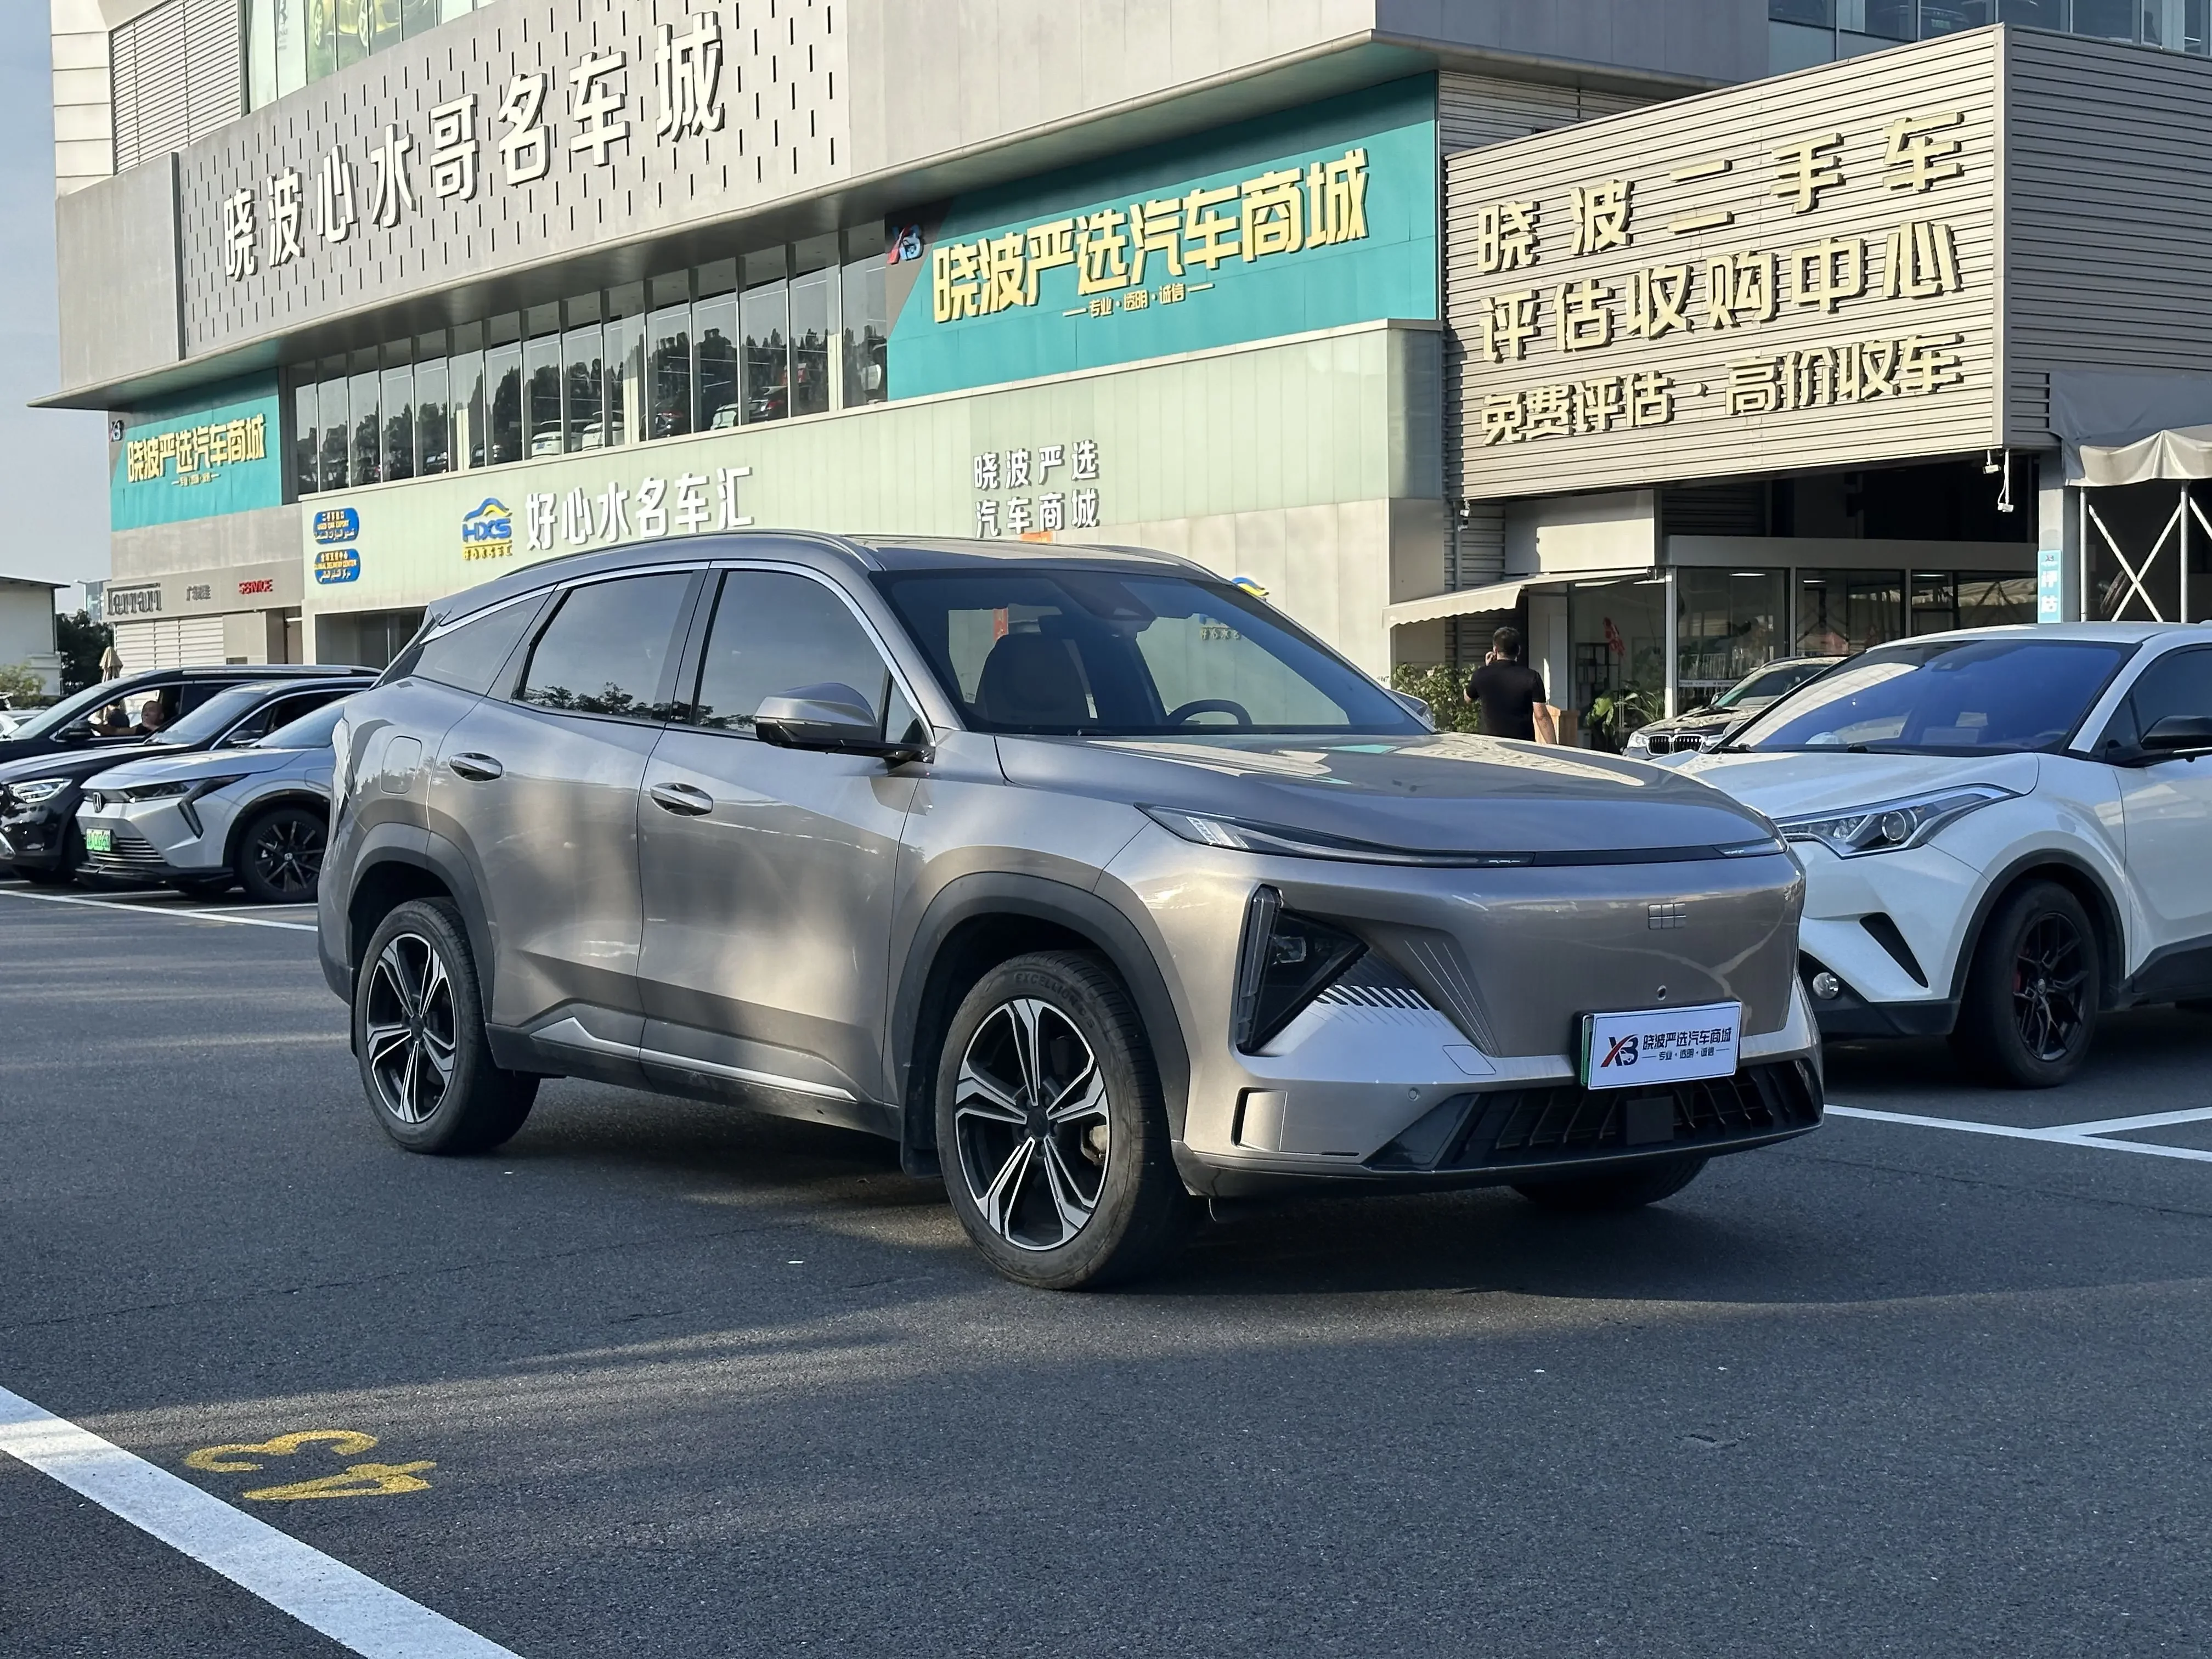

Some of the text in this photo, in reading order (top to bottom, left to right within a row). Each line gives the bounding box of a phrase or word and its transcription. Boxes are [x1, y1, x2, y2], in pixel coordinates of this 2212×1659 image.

[222, 11, 725, 282] 晓波心水哥名车城
[1477, 111, 1964, 273] 晓波二手车
[932, 147, 1370, 325] 晓波严选汽车商城
[1479, 222, 1964, 363] 评估收购中心
[1480, 332, 1964, 447] 免费评估·高价收车
[127, 413, 267, 483] 晓波严选汽车商城
[973, 439, 1101, 492] 晓波严选
[526, 466, 755, 551] 好心水名车汇
[975, 488, 1101, 539] 汽车商城
[1642, 1026, 1732, 1050] 晓波严选汽车商城
